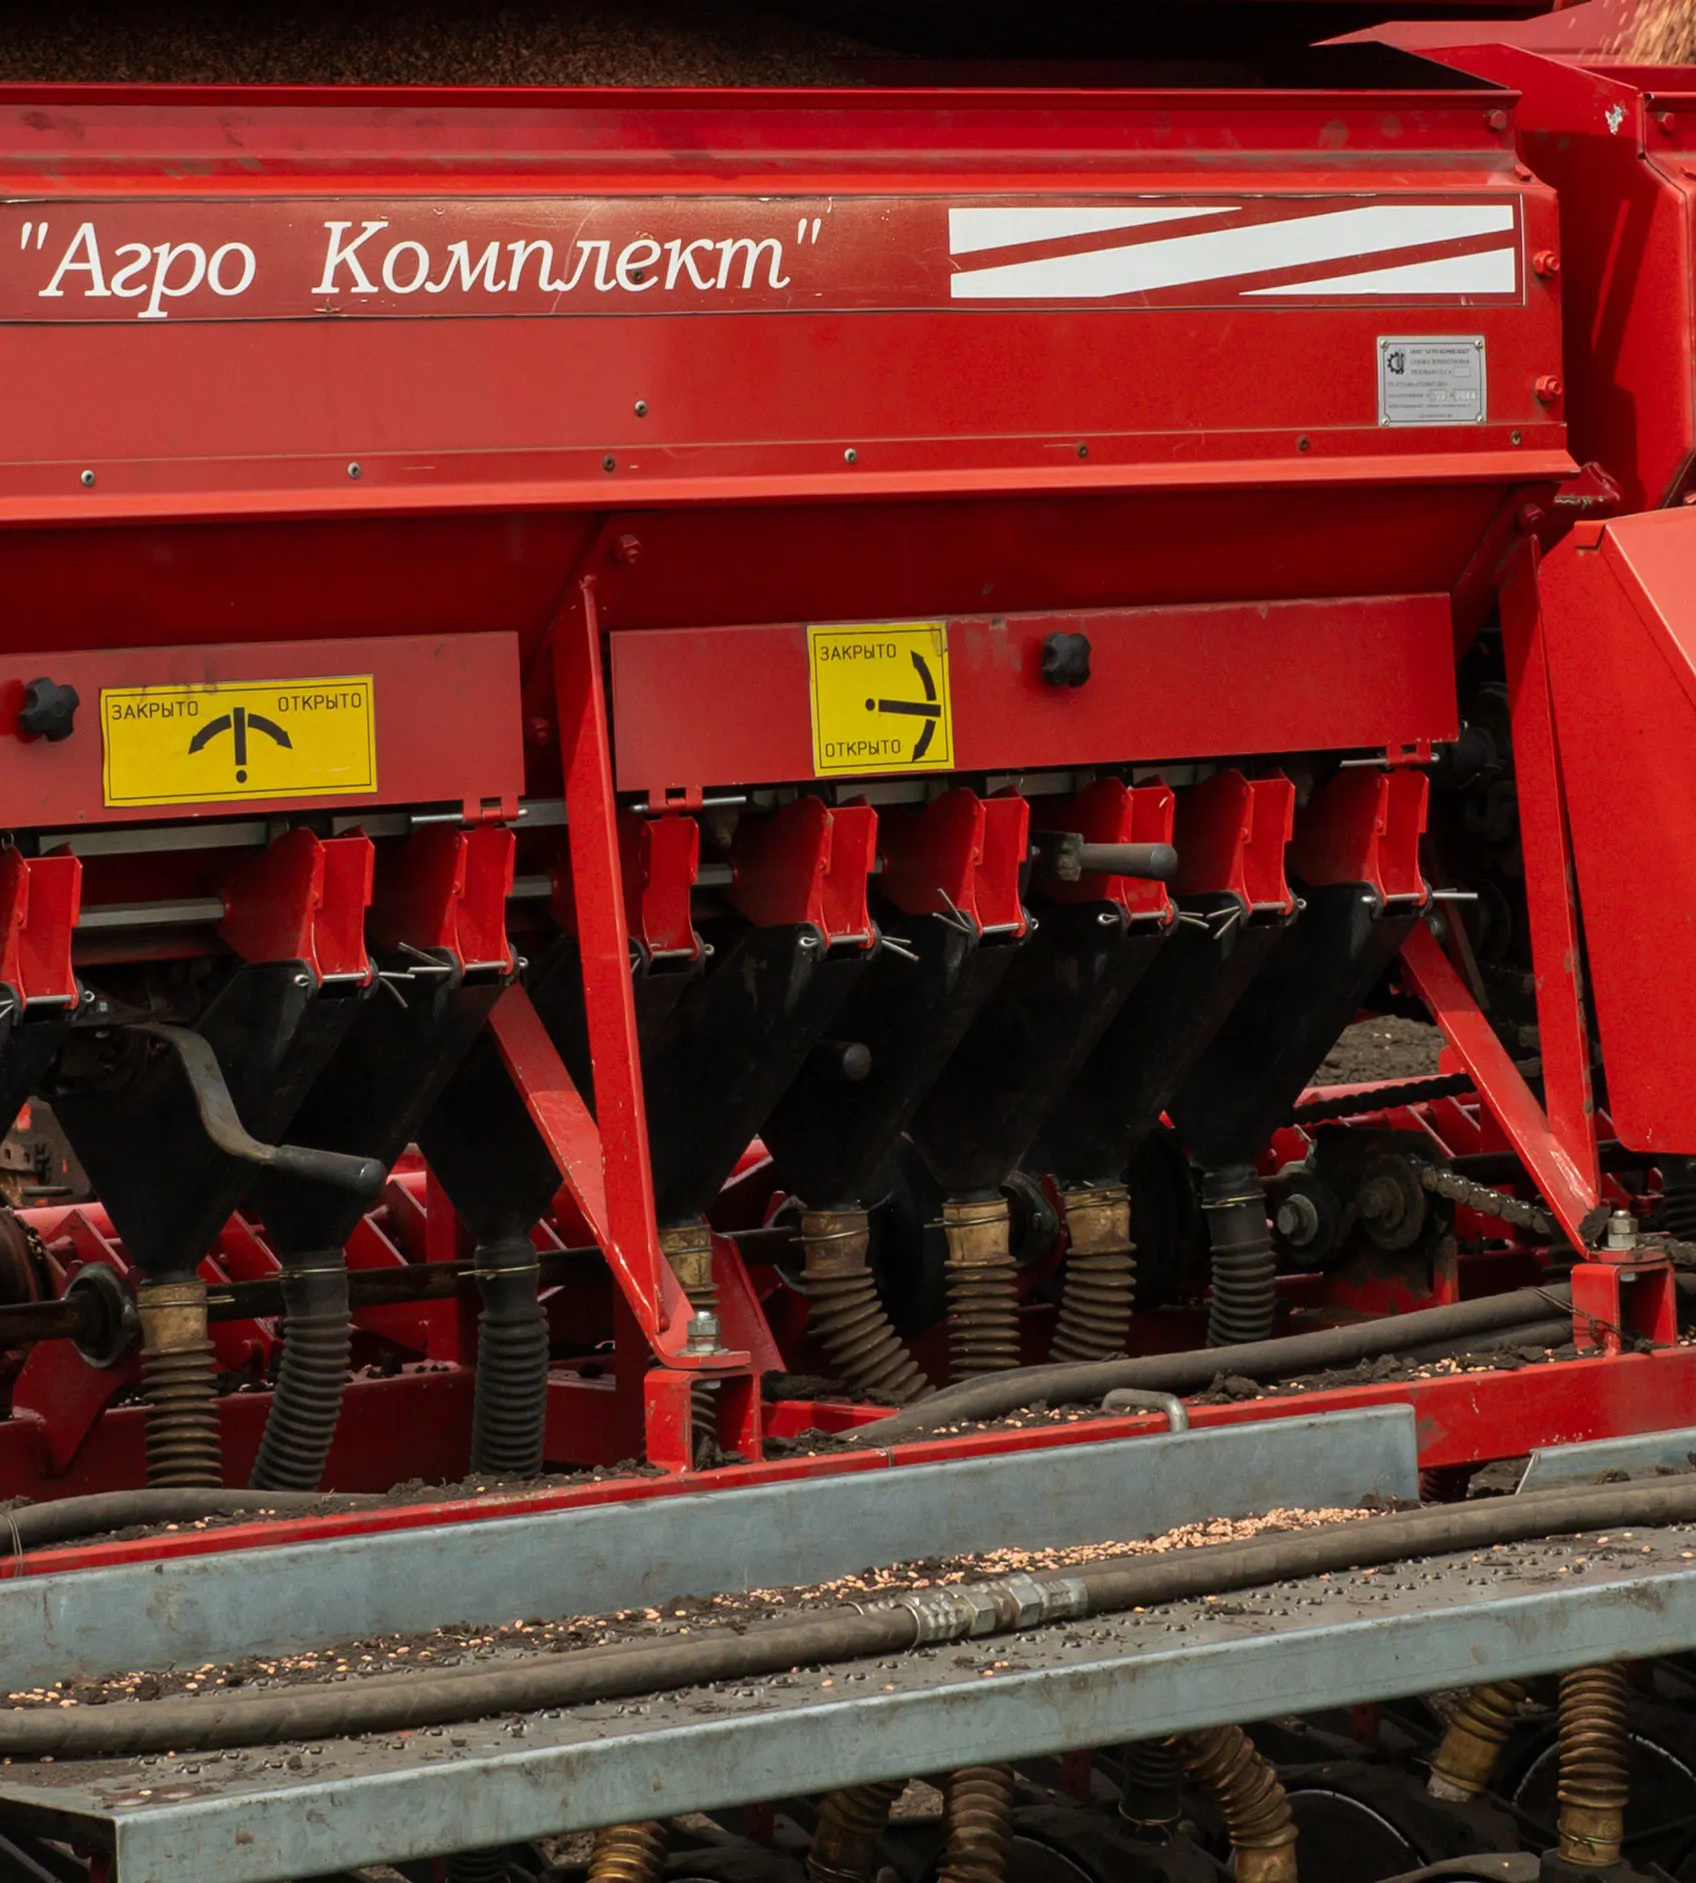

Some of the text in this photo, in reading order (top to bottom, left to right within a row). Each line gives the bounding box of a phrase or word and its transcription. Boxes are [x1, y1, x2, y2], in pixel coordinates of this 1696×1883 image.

[19, 217, 823, 319] "Агро Комплект"
[819, 643, 897, 662] ЗАКРЫТО
[111, 692, 362, 721] ЗАКРЫТО ОТКРЫТО
[824, 738, 902, 758] ОТКРЫТО
